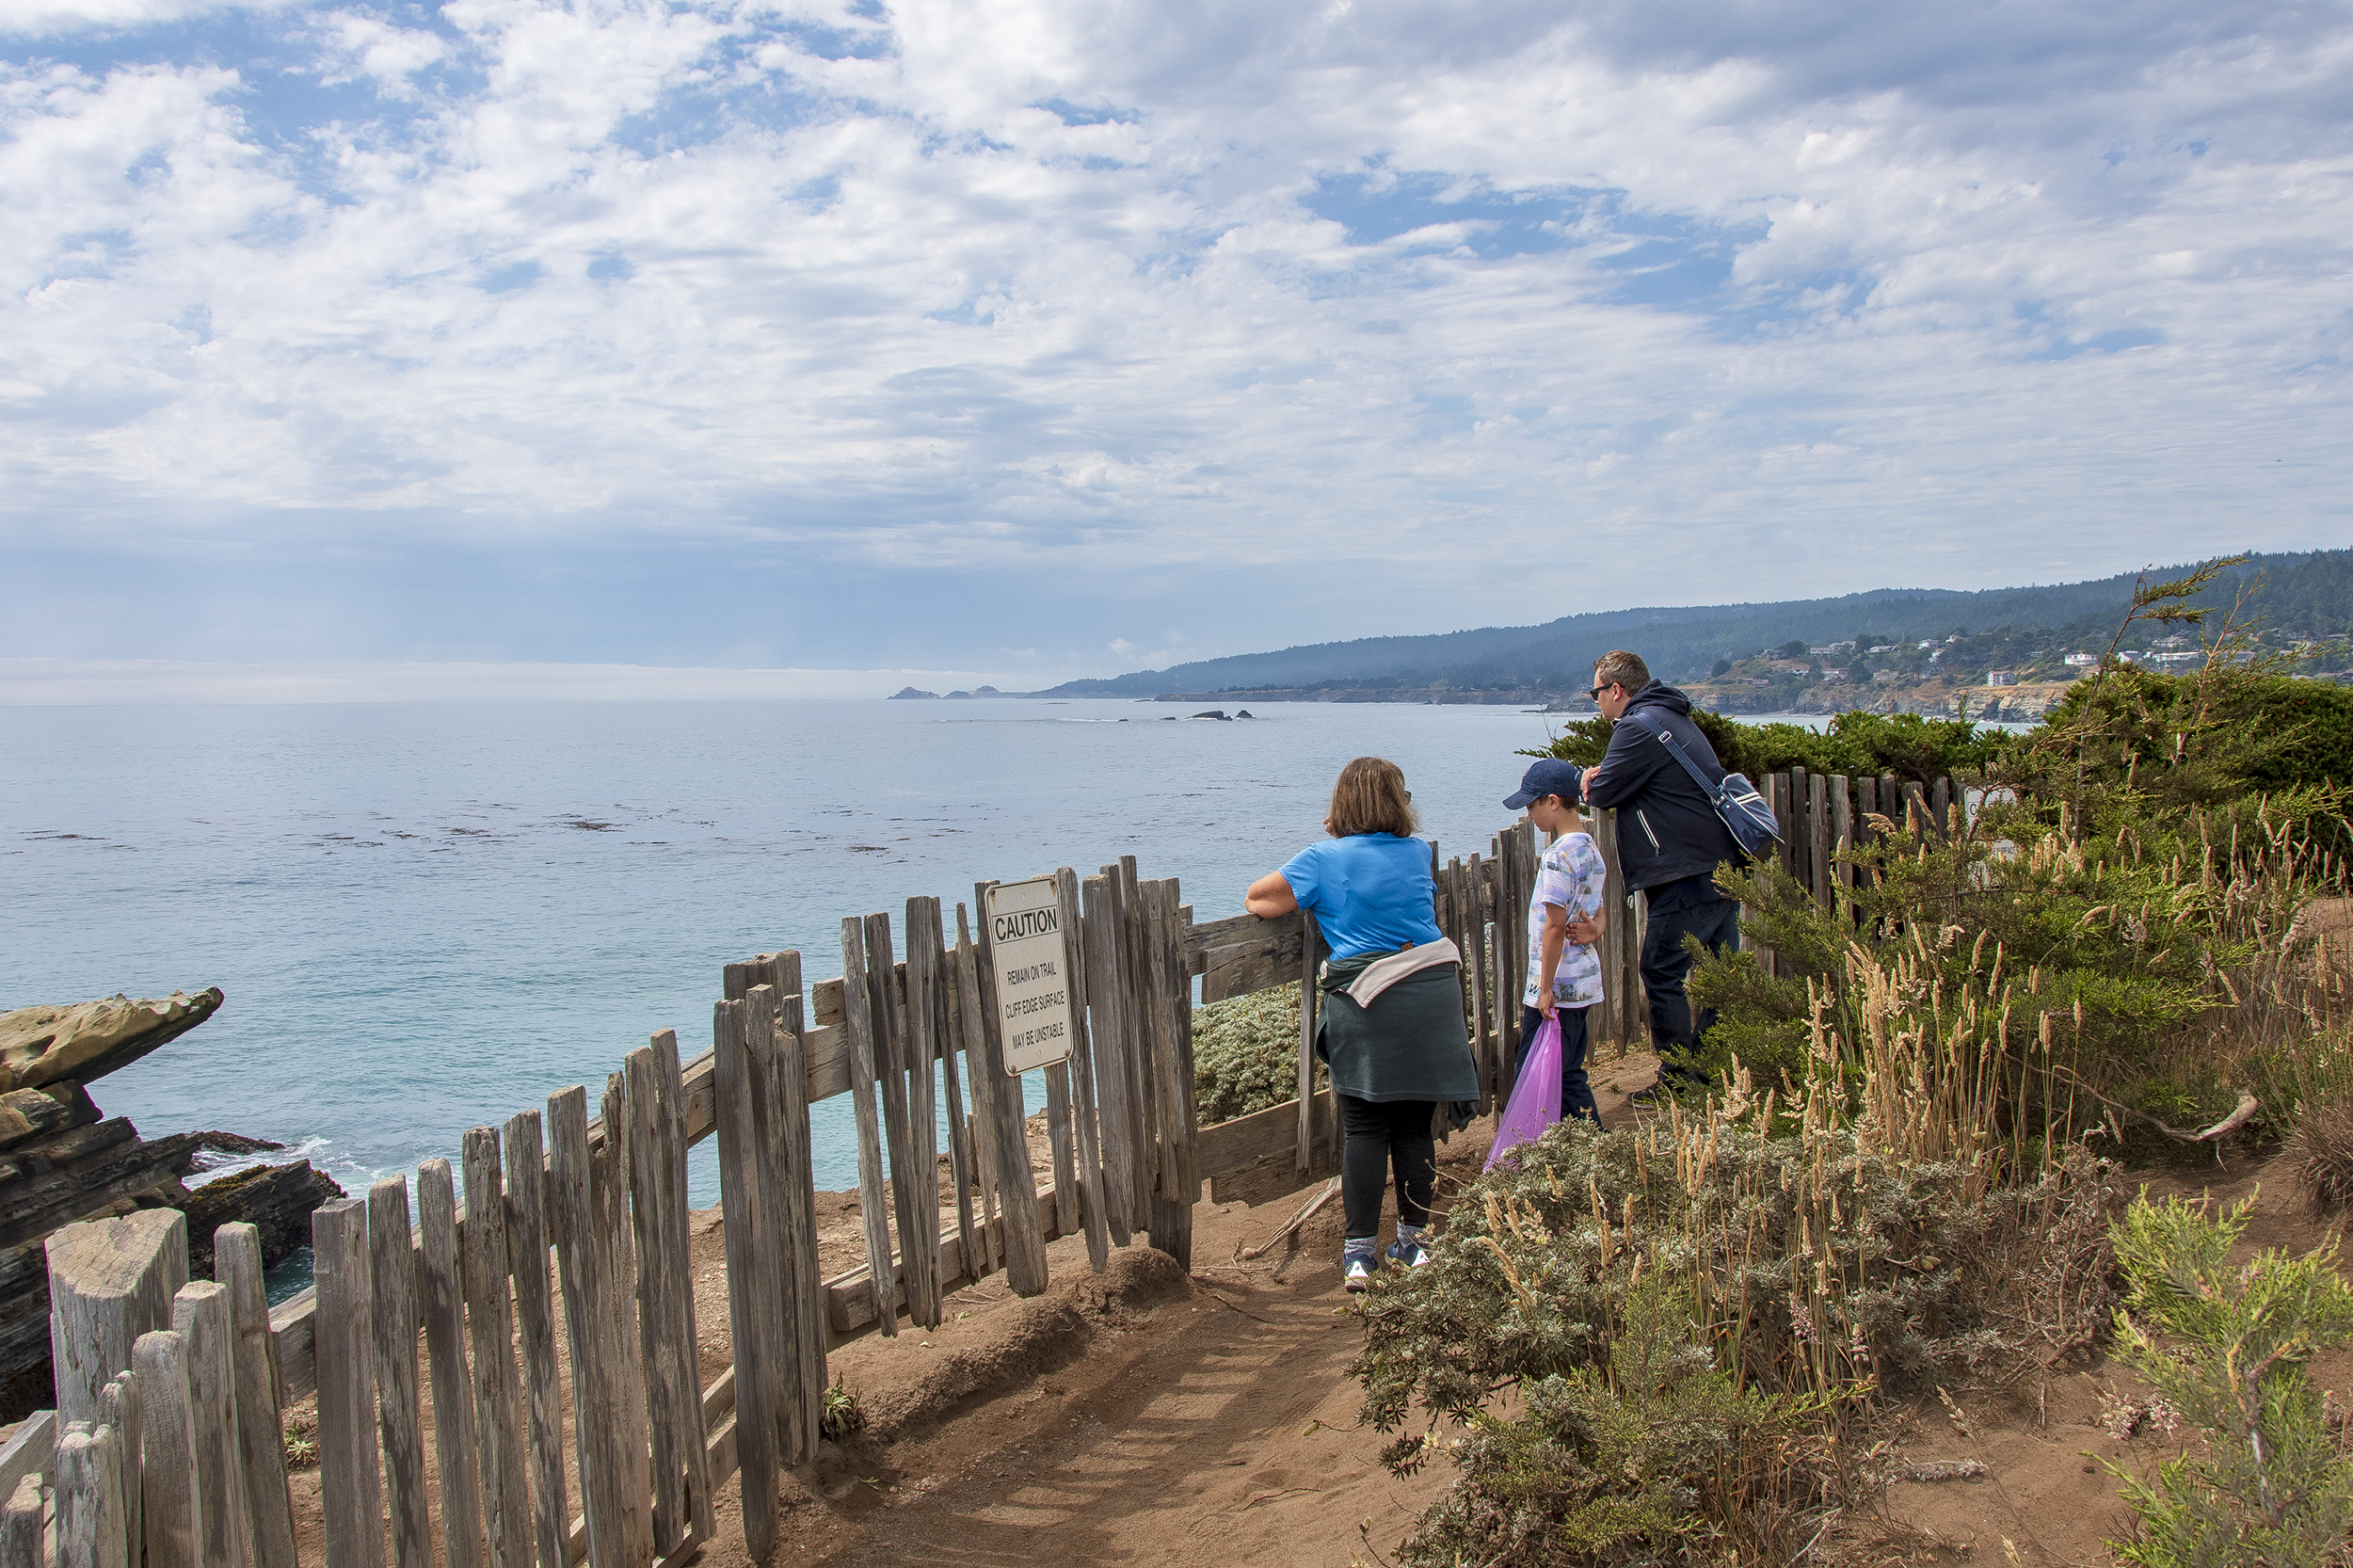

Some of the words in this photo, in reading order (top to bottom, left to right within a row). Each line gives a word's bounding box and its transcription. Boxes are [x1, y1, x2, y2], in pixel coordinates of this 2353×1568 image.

[995, 908, 1057, 940] CAUTION
[1007, 967, 1030, 985] REMAIN
[1031, 965, 1040, 980] ON
[1039, 961, 1056, 978] TRAIL
[1005, 1000, 1021, 1019] CLIFF
[1022, 998, 1038, 1015] EDGE
[1038, 990, 1064, 1010] SURFACE
[1012, 1032, 1025, 1049] MAY
[1026, 1030, 1034, 1046] BE
[1034, 1022, 1064, 1043] UNSTABLE
